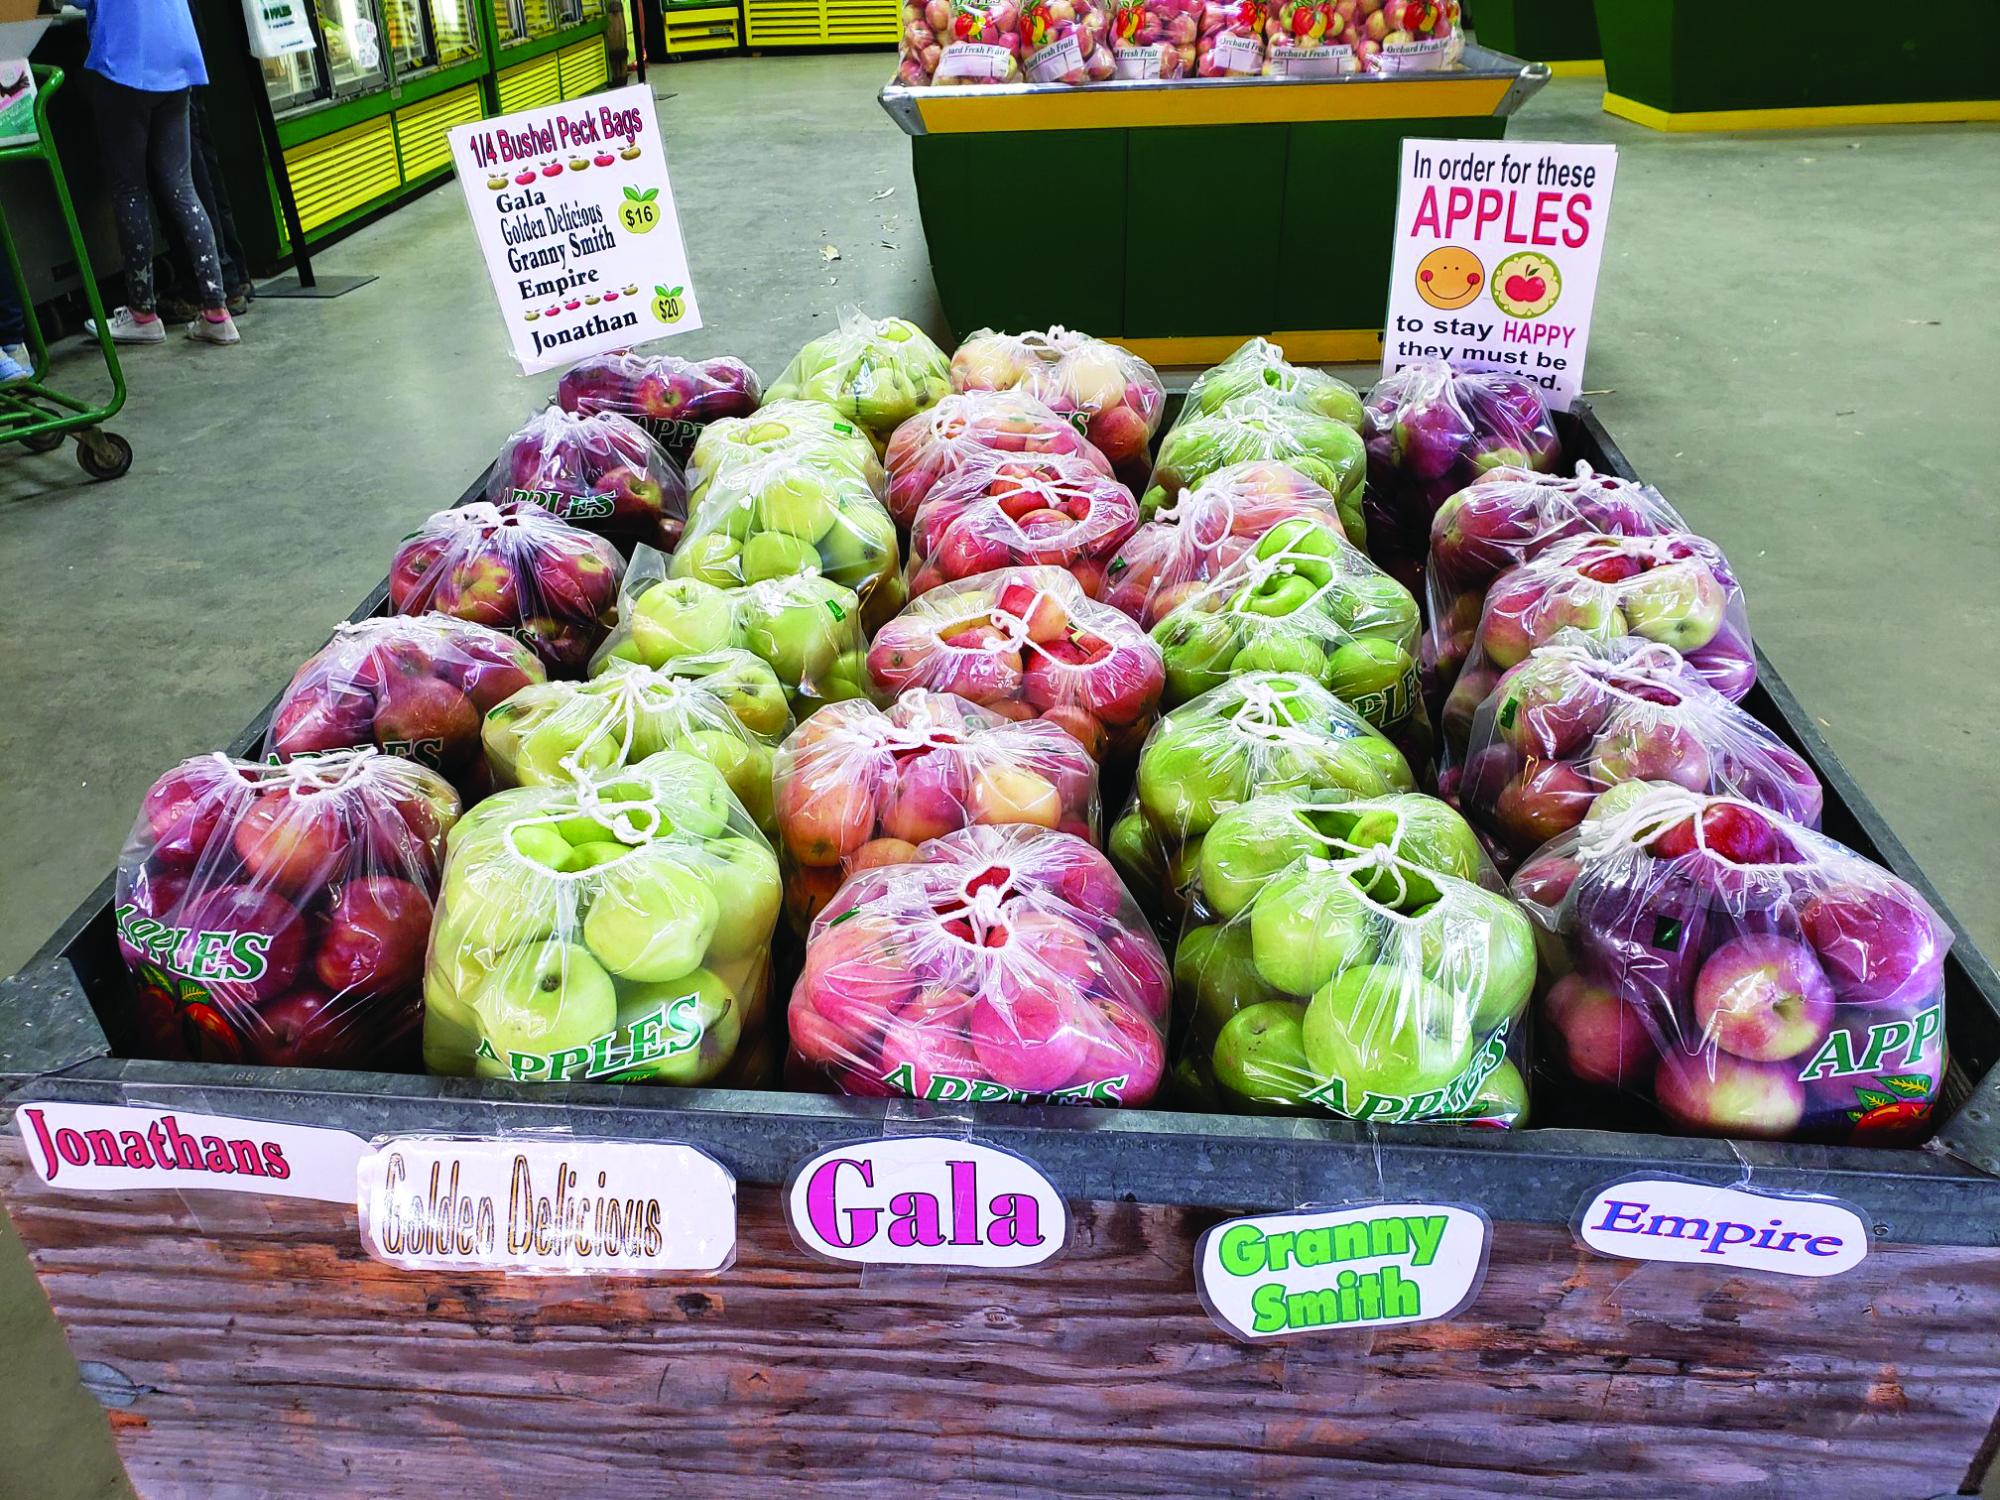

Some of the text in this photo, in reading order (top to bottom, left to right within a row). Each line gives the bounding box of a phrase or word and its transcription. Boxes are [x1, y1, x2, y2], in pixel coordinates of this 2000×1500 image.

[1274, 47, 1348, 58] Orchard Fresh Fruit
[470, 106, 643, 168] 1/4 Bushel Peck Bags
[1413, 150, 1596, 188] In order for these
[496, 188, 547, 214] Gala
[500, 200, 603, 247] Golden Delicious
[625, 206, 653, 228] $16
[1410, 185, 1593, 249] APPLES
[507, 224, 616, 275] Granny Smith
[518, 266, 600, 300] Empire
[531, 310, 638, 357] Jonathan
[659, 298, 679, 320] $20
[1396, 315, 1576, 349] to stay HAPPY
[1462, 347, 1529, 366] must
[1536, 351, 1568, 370] be
[475, 992, 705, 1082] APPLES
[1798, 1005, 1941, 1082] APP
[24, 1109, 291, 1181] Jonathans
[382, 1152, 662, 1257] Golden Delicious
[806, 1158, 1046, 1249] Gala
[1590, 1199, 1844, 1257] Empire
[1218, 1215, 1450, 1277] Granny
[1251, 1265, 1422, 1333] Smith
